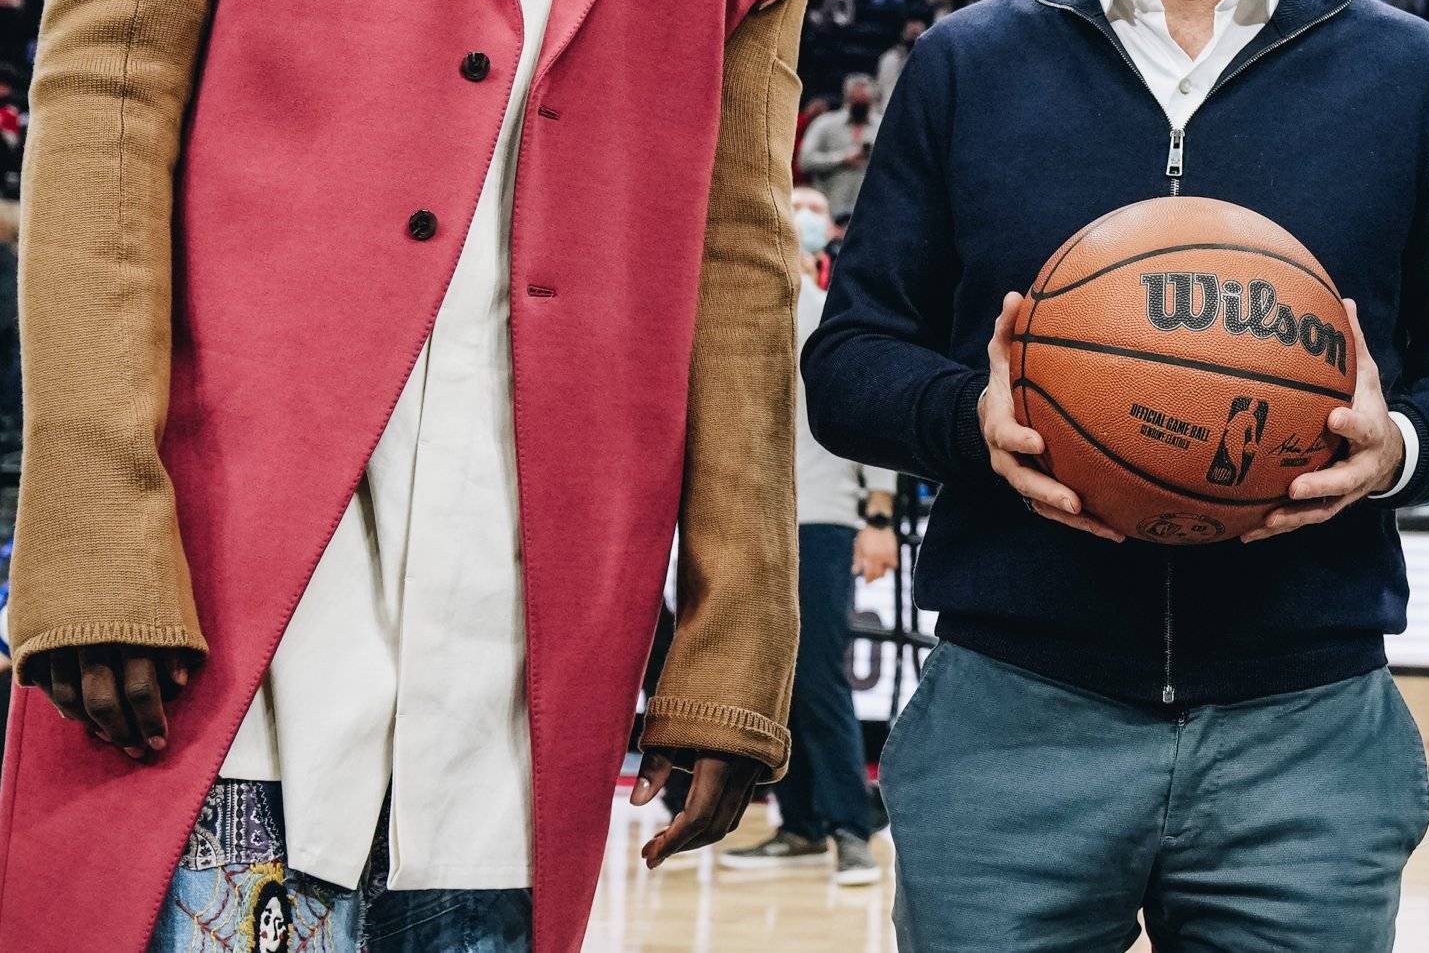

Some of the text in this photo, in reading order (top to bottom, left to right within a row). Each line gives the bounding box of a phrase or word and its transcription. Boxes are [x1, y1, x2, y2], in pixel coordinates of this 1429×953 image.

[1139, 271, 1348, 377] Wilson
[1130, 403, 1211, 442] OFFICIAL GAME BALL
